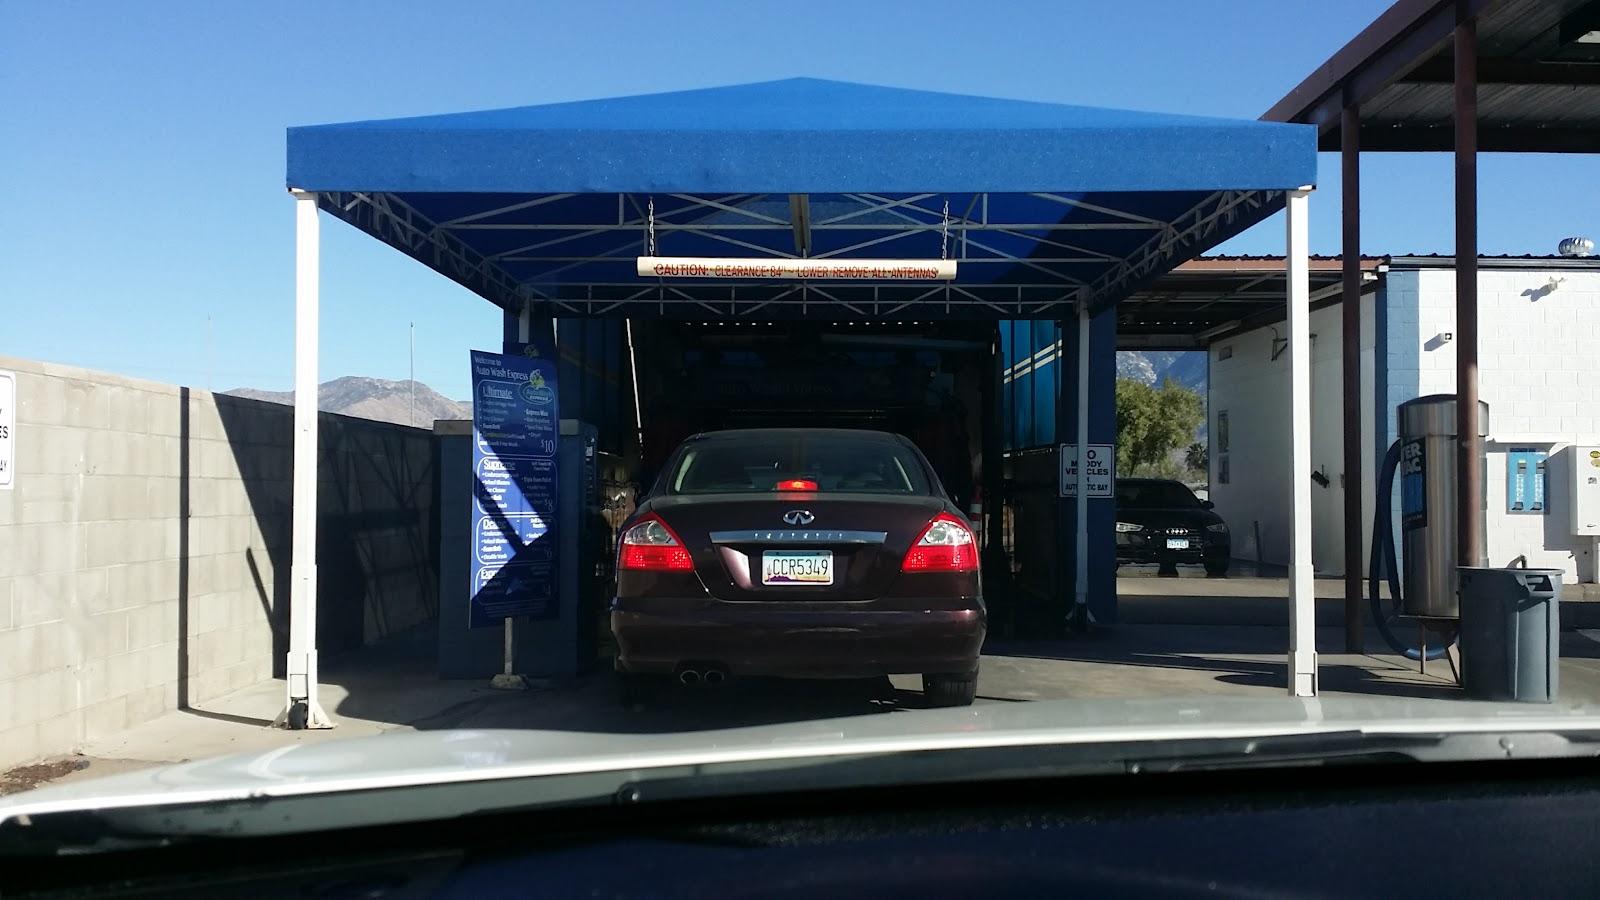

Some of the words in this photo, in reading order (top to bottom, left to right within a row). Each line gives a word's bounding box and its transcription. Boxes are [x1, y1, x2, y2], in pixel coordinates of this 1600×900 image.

[714, 264, 767, 278] CLEARANCE
[872, 267, 888, 279] ALL
[890, 266, 938, 279] ANTENNAS
[474, 355, 496, 366] Welcome
[496, 359, 502, 367] to
[475, 365, 490, 376] Auto
[490, 366, 507, 379] Wash
[507, 369, 529, 381] Express
[482, 385, 513, 399] Ultimate
[1070, 460, 1103, 468] MDY
[1065, 467, 1110, 476] VECLES
[772, 558, 829, 576] CCR5349
